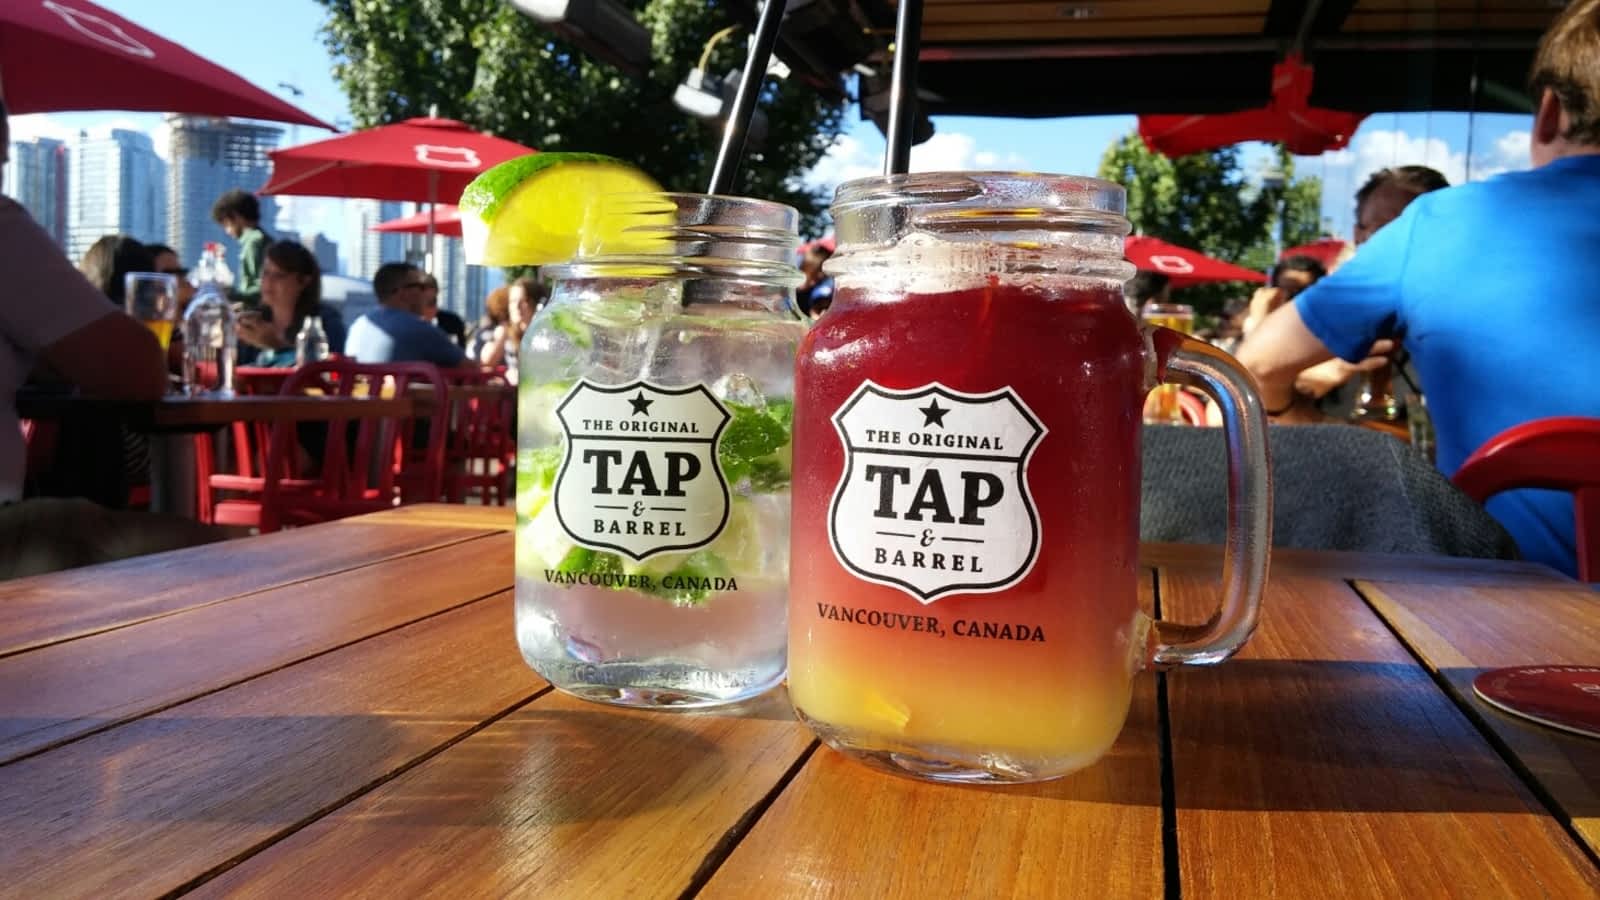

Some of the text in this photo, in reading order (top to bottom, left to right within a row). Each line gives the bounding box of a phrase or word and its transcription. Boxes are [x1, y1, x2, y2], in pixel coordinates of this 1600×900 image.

[583, 419, 699, 434] THE ORIGINAL
[866, 429, 1003, 450] THE ORIGINAL
[583, 449, 702, 497] TAP
[865, 464, 1004, 526] TAP
[632, 501, 645, 516] &
[593, 519, 686, 537] BARREL
[921, 528, 935, 547] &
[874, 547, 983, 573] BARREL
[544, 569, 738, 592] VANCOUVER, CANADA
[816, 602, 1046, 642] VANCOUVER, CANADA
